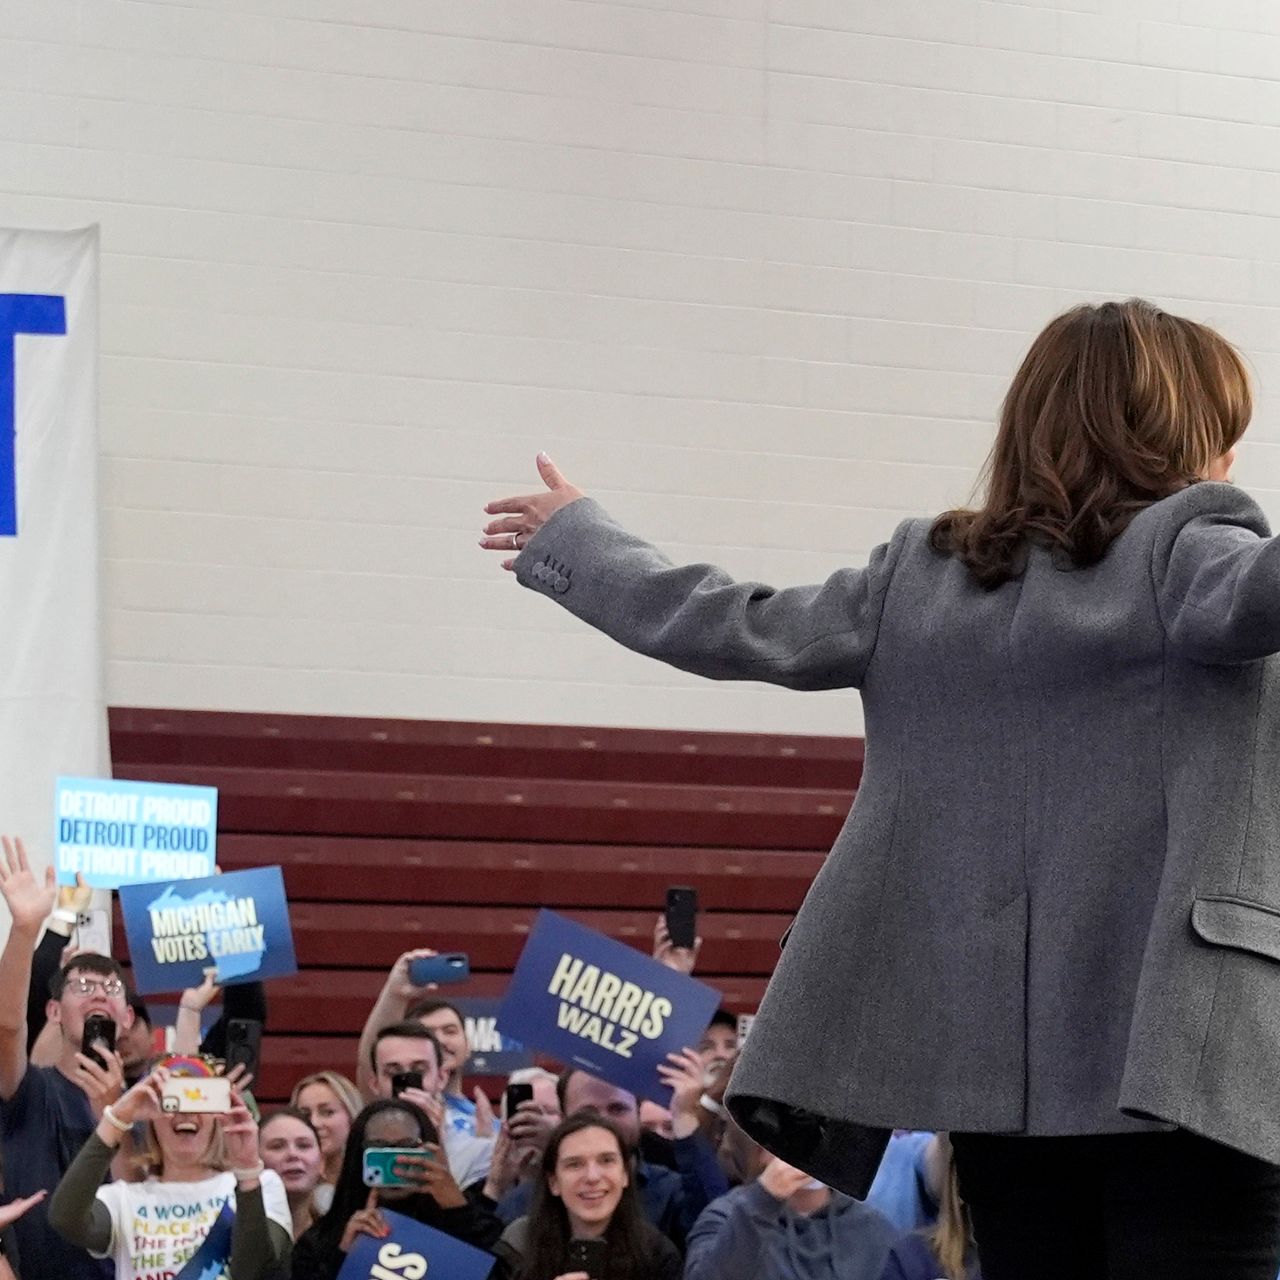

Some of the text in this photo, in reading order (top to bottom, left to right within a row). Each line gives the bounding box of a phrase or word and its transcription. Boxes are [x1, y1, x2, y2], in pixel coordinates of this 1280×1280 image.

[59, 789, 212, 826] DETROIT PROUD
[59, 818, 209, 853] DETROIT PROUD
[59, 844, 141, 876] DETROIT
[150, 896, 258, 937] MICHIGAN
[151, 924, 265, 964] VOTES EARLY
[548, 952, 672, 1040] HARRIS
[556, 1001, 640, 1059] WALZ
[133, 1217, 191, 1236] PLACE
[131, 1251, 165, 1271] THE
